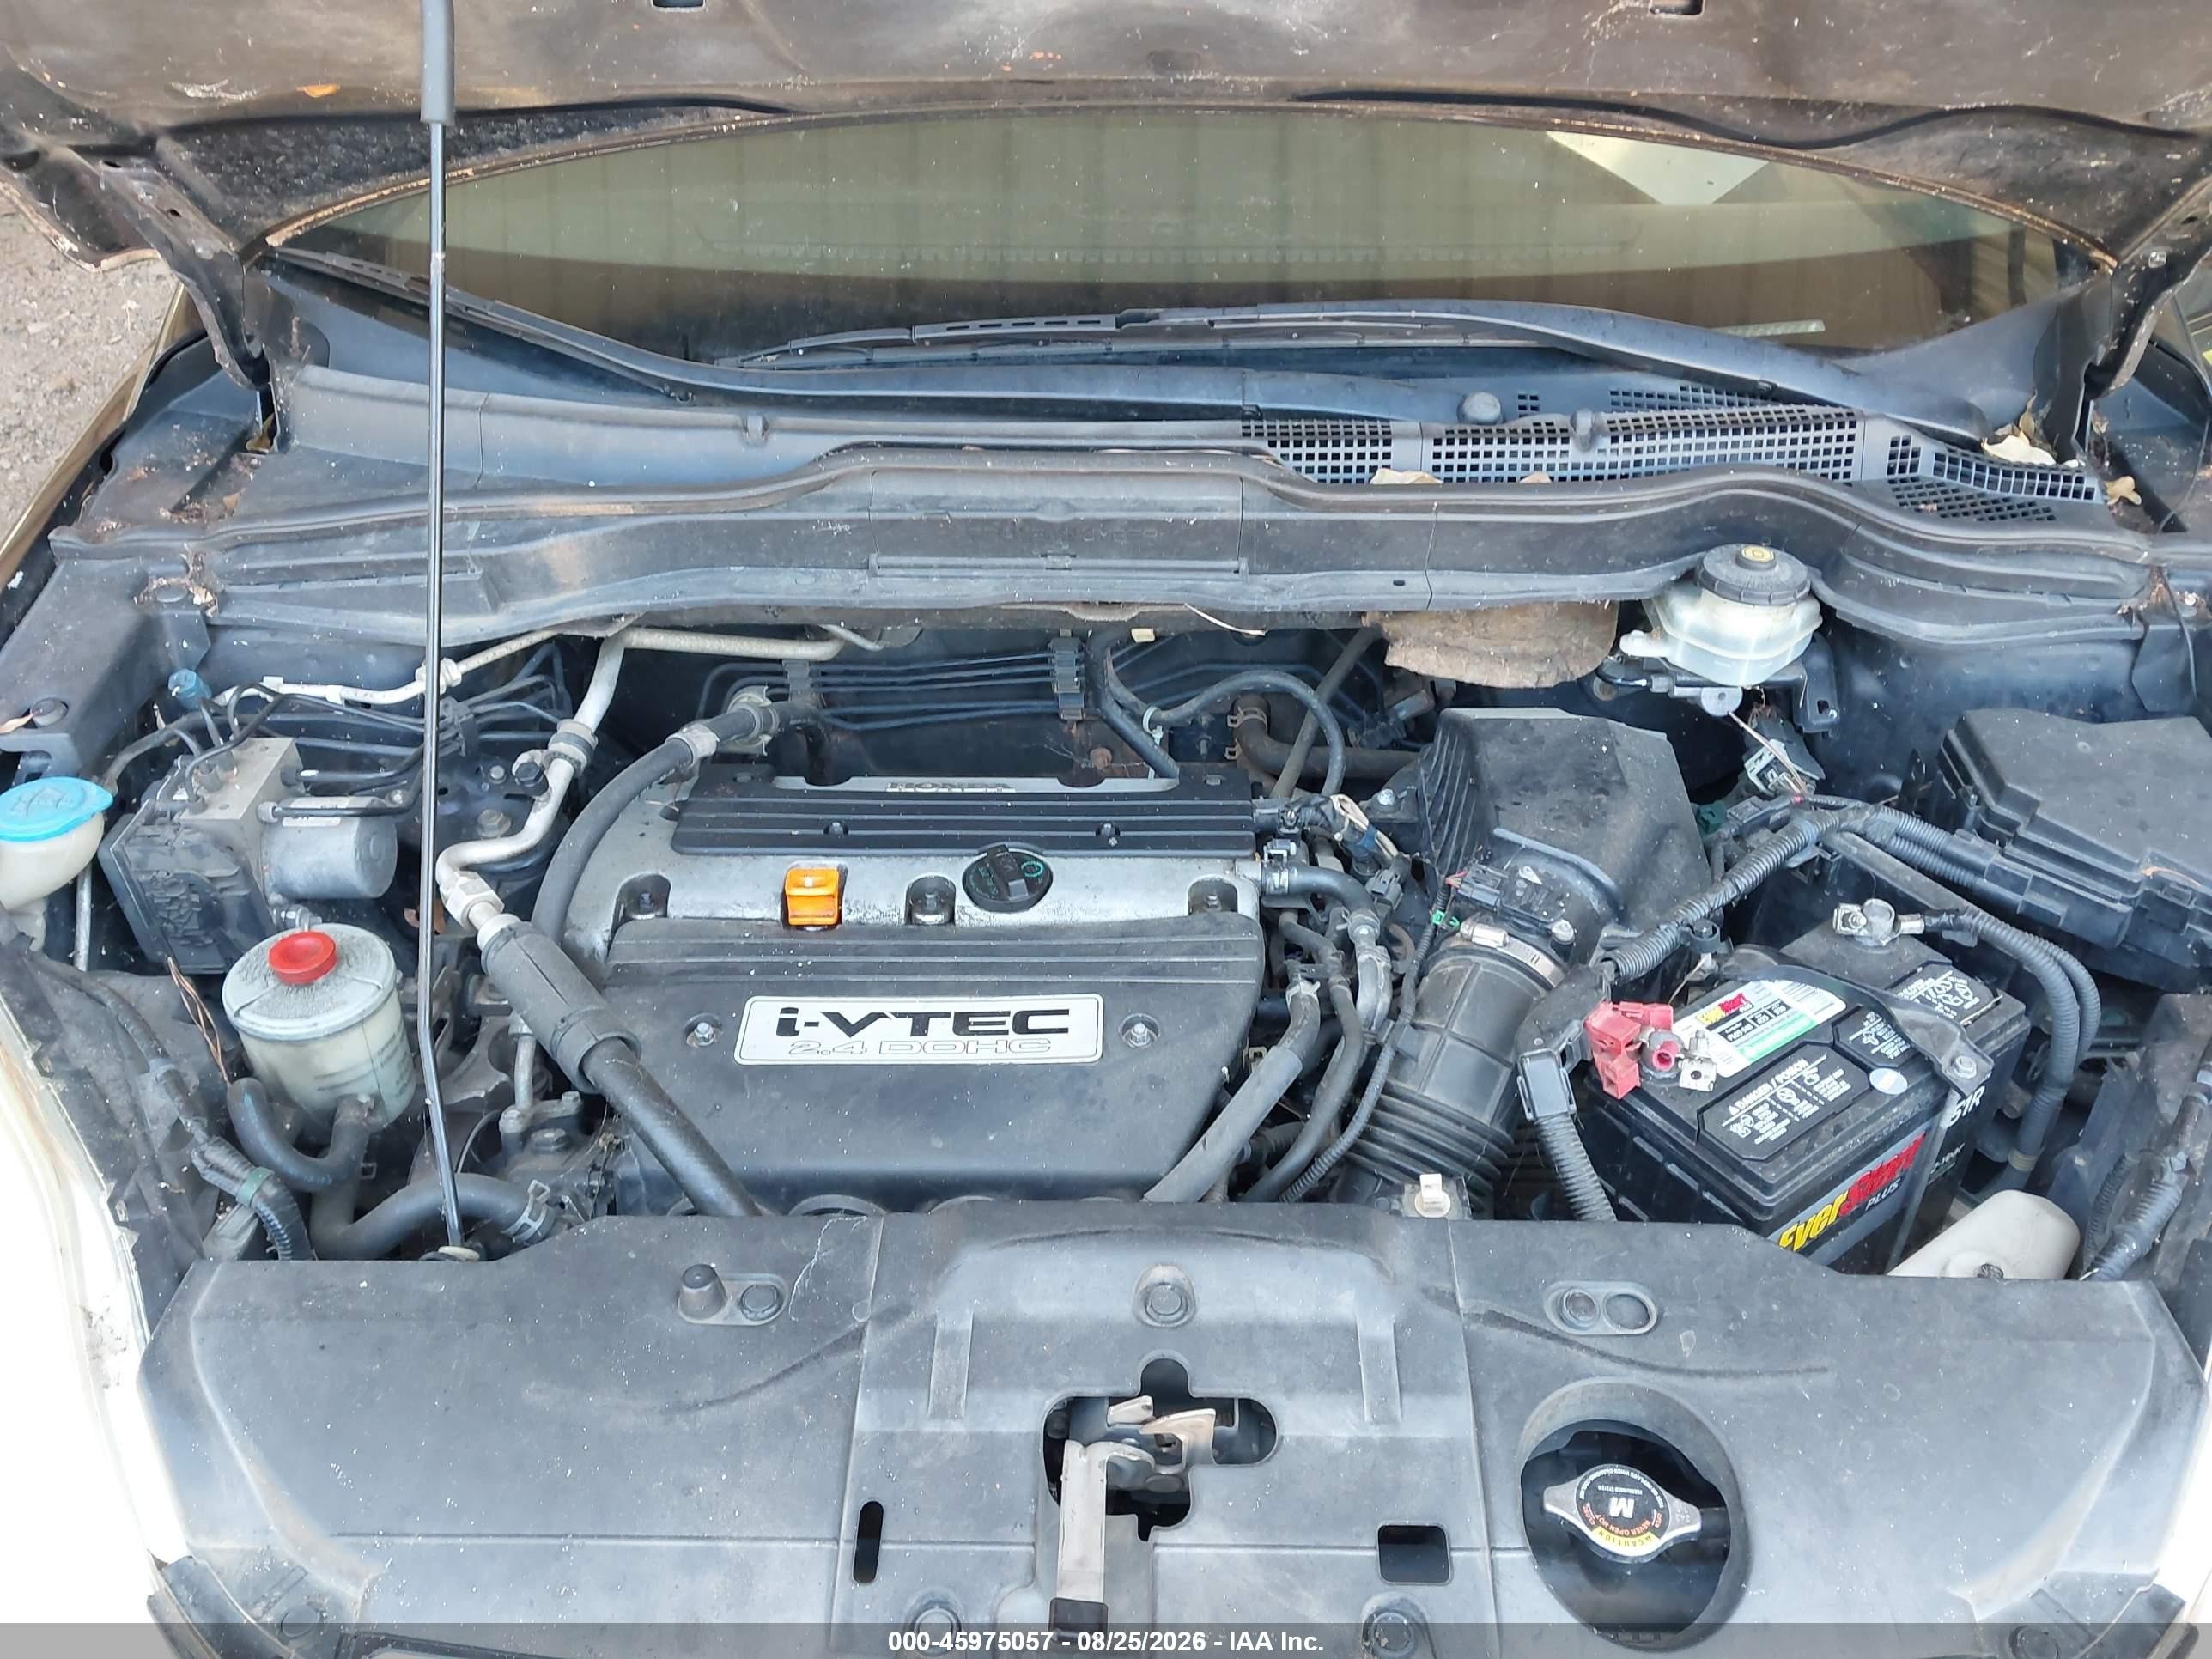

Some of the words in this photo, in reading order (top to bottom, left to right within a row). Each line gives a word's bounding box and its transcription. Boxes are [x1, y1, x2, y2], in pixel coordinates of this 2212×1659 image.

[886, 781, 1016, 793] HONDA
[776, 1007, 1070, 1037] i-VTEC
[788, 1039, 868, 1055] 2.4
[879, 1038, 1052, 1055] DOHC
[1949, 1085, 1985, 1127] 51R
[1865, 1177, 1901, 1212] PLUS
[1609, 1497, 1635, 1519] M
[1595, 1514, 1609, 1528] HOT
[1608, 1525, 1630, 1536] OPEN
